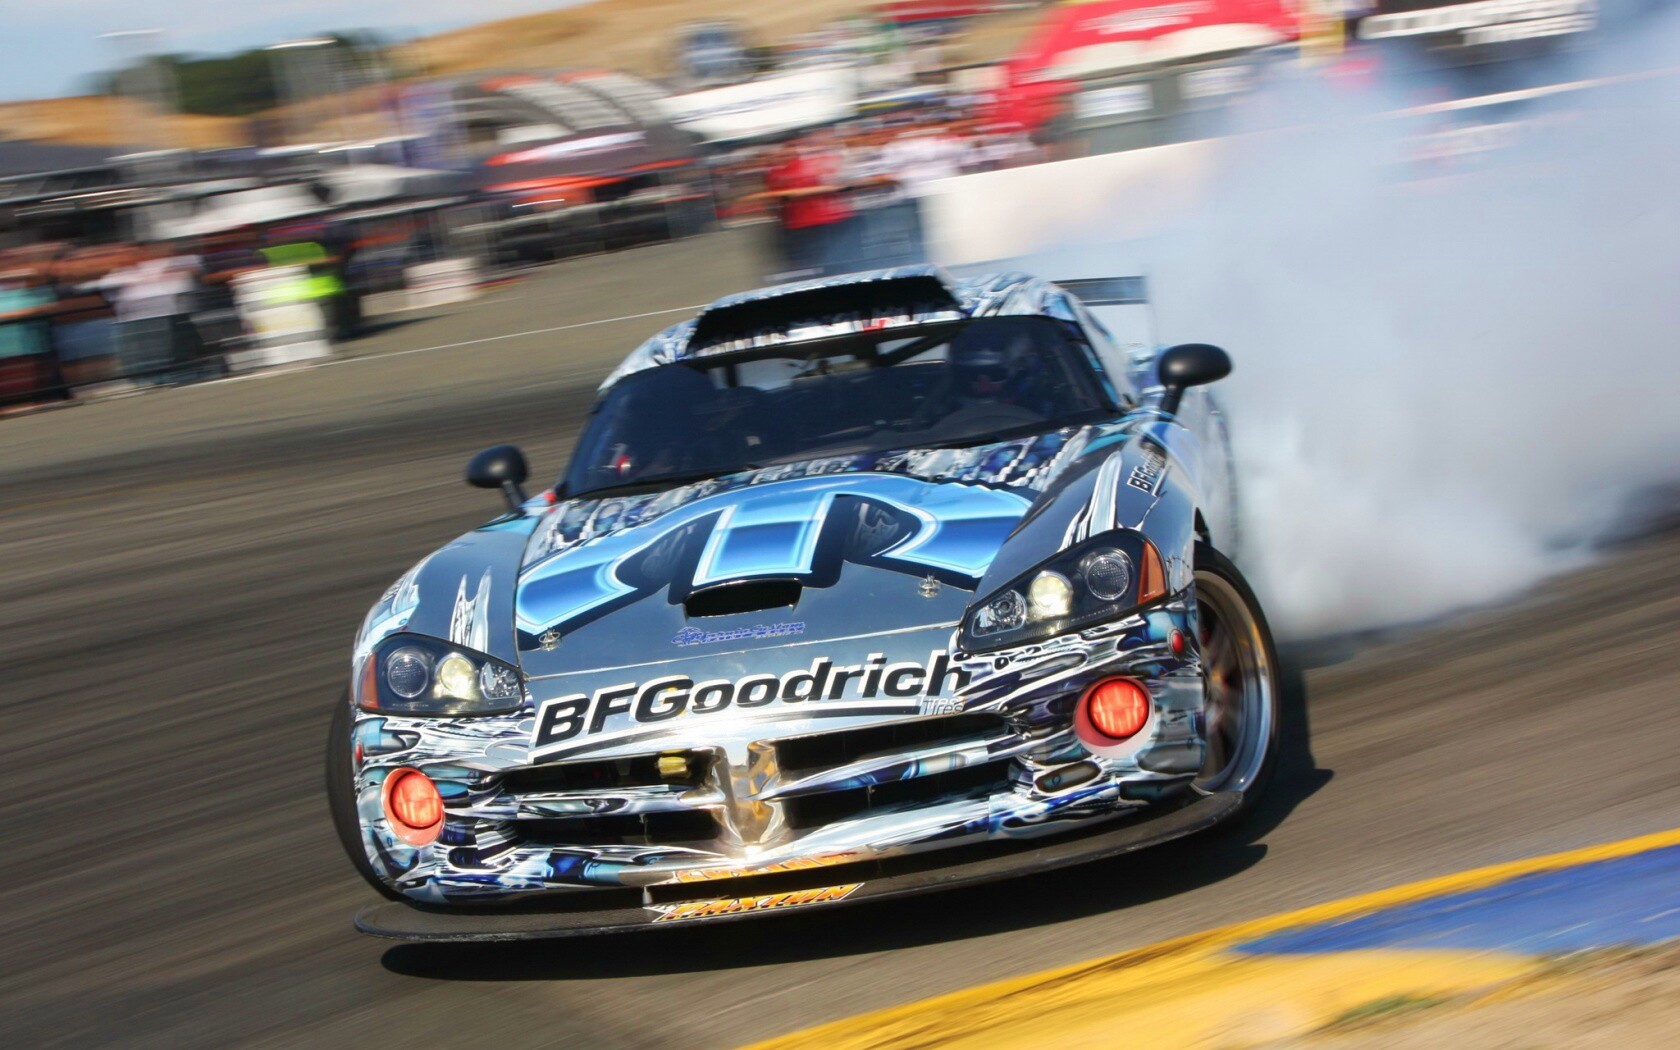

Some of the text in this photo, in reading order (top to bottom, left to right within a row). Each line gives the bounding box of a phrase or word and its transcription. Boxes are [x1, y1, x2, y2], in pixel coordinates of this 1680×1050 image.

[1127, 449, 1166, 494] BFGood
[531, 650, 973, 748] BFGoodrich
[920, 696, 963, 716] Tires
